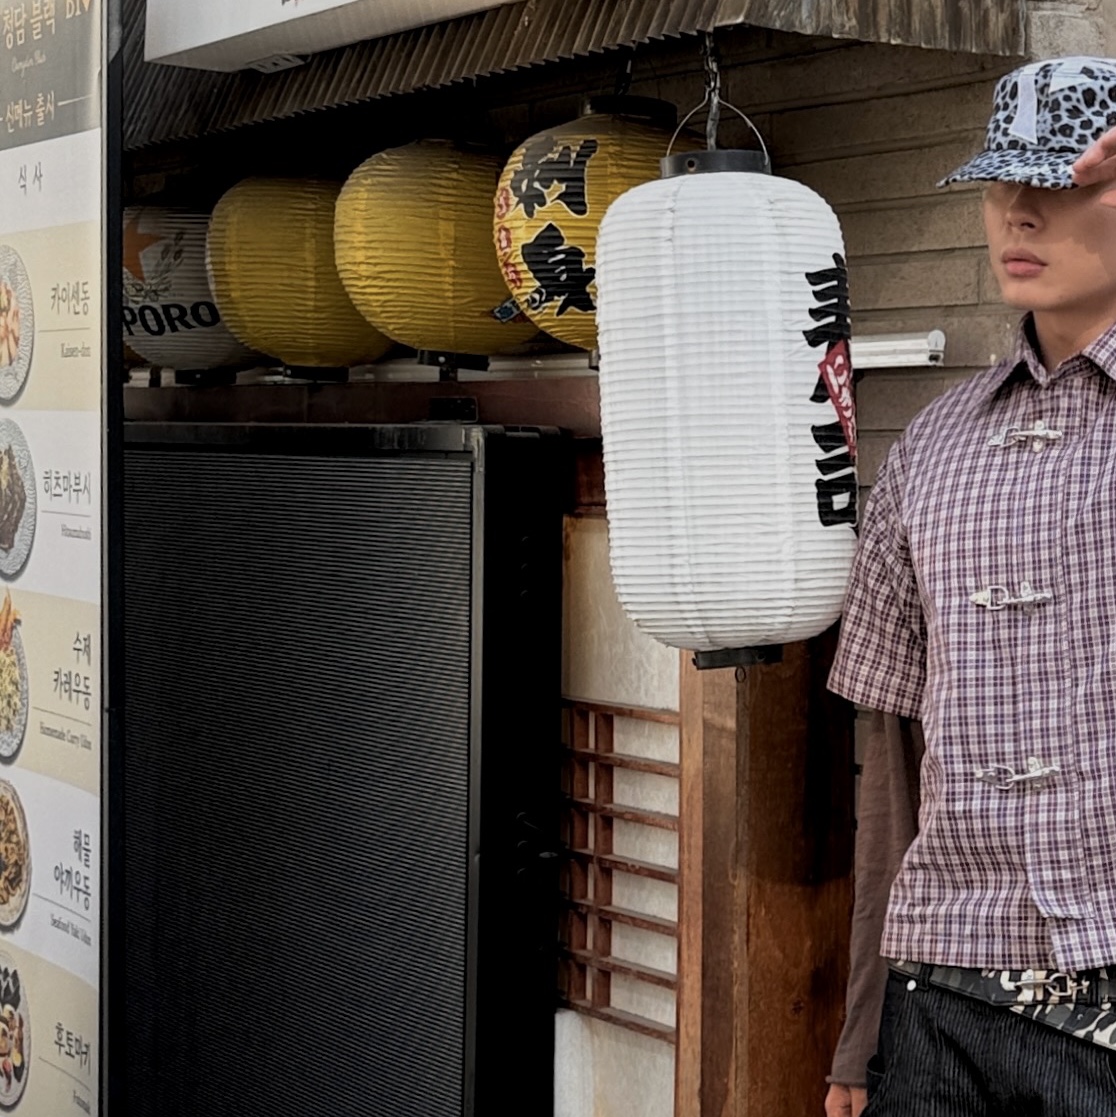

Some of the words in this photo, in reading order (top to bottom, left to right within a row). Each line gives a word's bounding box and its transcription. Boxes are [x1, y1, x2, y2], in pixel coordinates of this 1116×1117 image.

[6, 99, 33, 133] 신메뉴
[36, 90, 55, 126] 출시
[51, 281, 90, 315] 카이센동
[43, 469, 91, 505] 히츠마부시
[73, 631, 91, 667] 수제
[53, 667, 92, 711] 카레우동
[73, 829, 92, 869] 해물
[54, 862, 92, 911] 야끼우동
[54, 1022, 92, 1076] 후토마키
